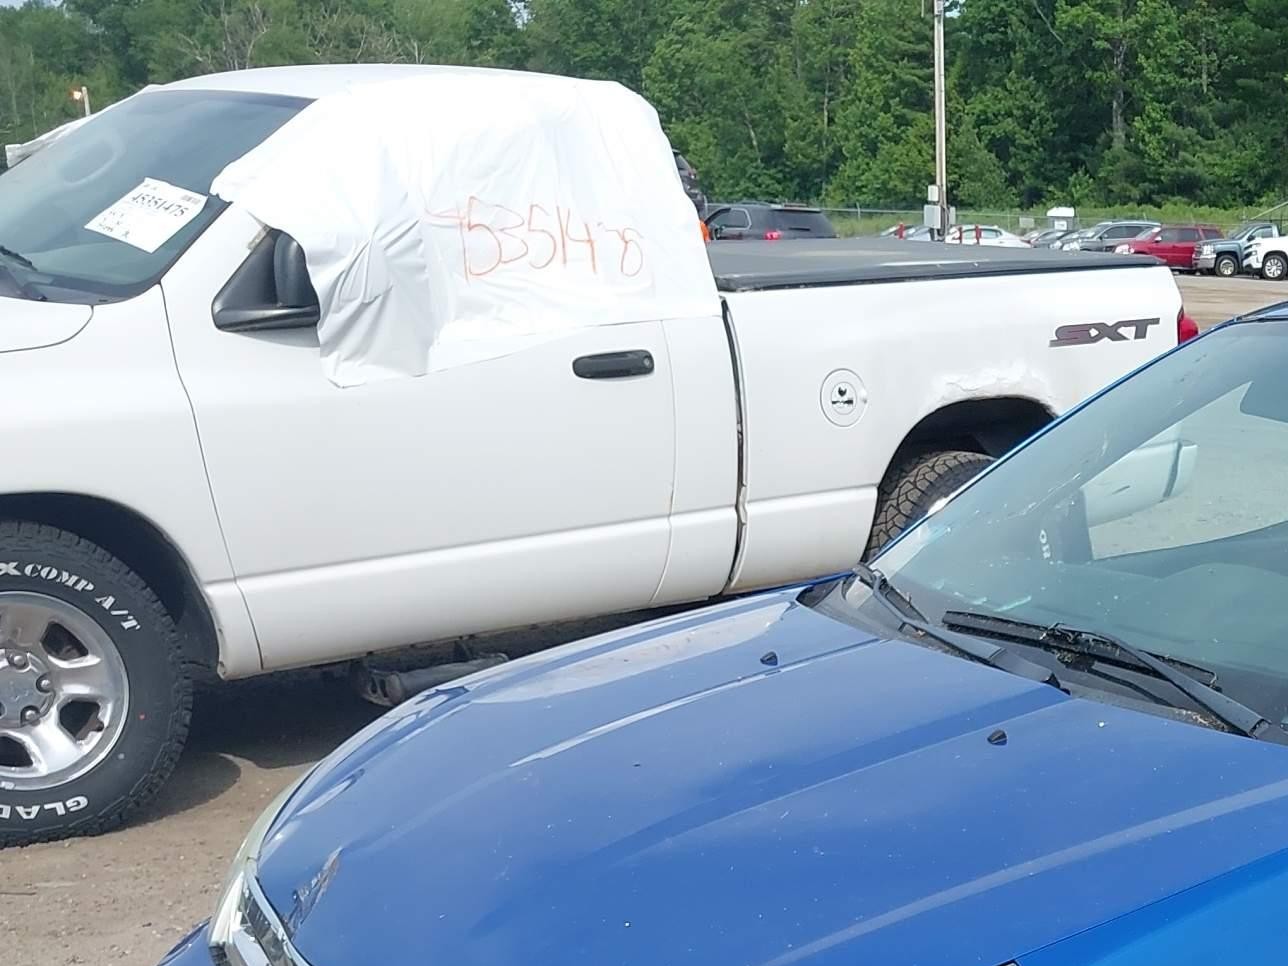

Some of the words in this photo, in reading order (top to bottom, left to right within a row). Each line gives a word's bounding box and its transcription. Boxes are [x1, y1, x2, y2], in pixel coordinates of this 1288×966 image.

[1048, 317, 1160, 348] SXT
[24, 563, 95, 592] COMP
[95, 595, 141, 630] A/T
